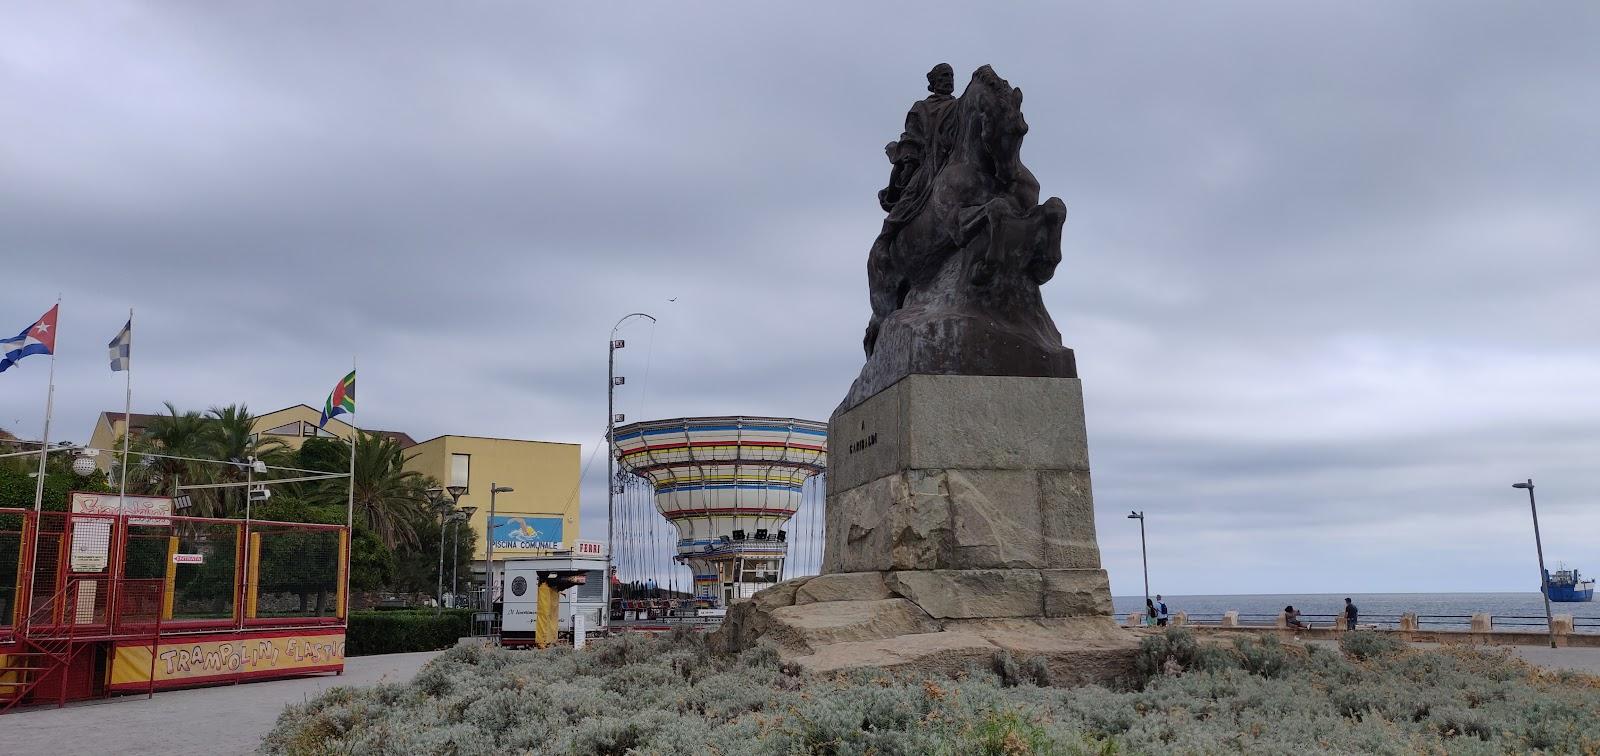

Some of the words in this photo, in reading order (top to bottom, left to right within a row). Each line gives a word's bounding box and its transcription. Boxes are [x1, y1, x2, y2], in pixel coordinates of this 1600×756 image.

[861, 420, 865, 430] A
[850, 432, 878, 454] GARIBALDI
[492, 540, 517, 549] PISCINA
[520, 541, 558, 550] COMUNALE
[579, 543, 601, 554] FERRI
[160, 640, 280, 675] TRAMPOLINI
